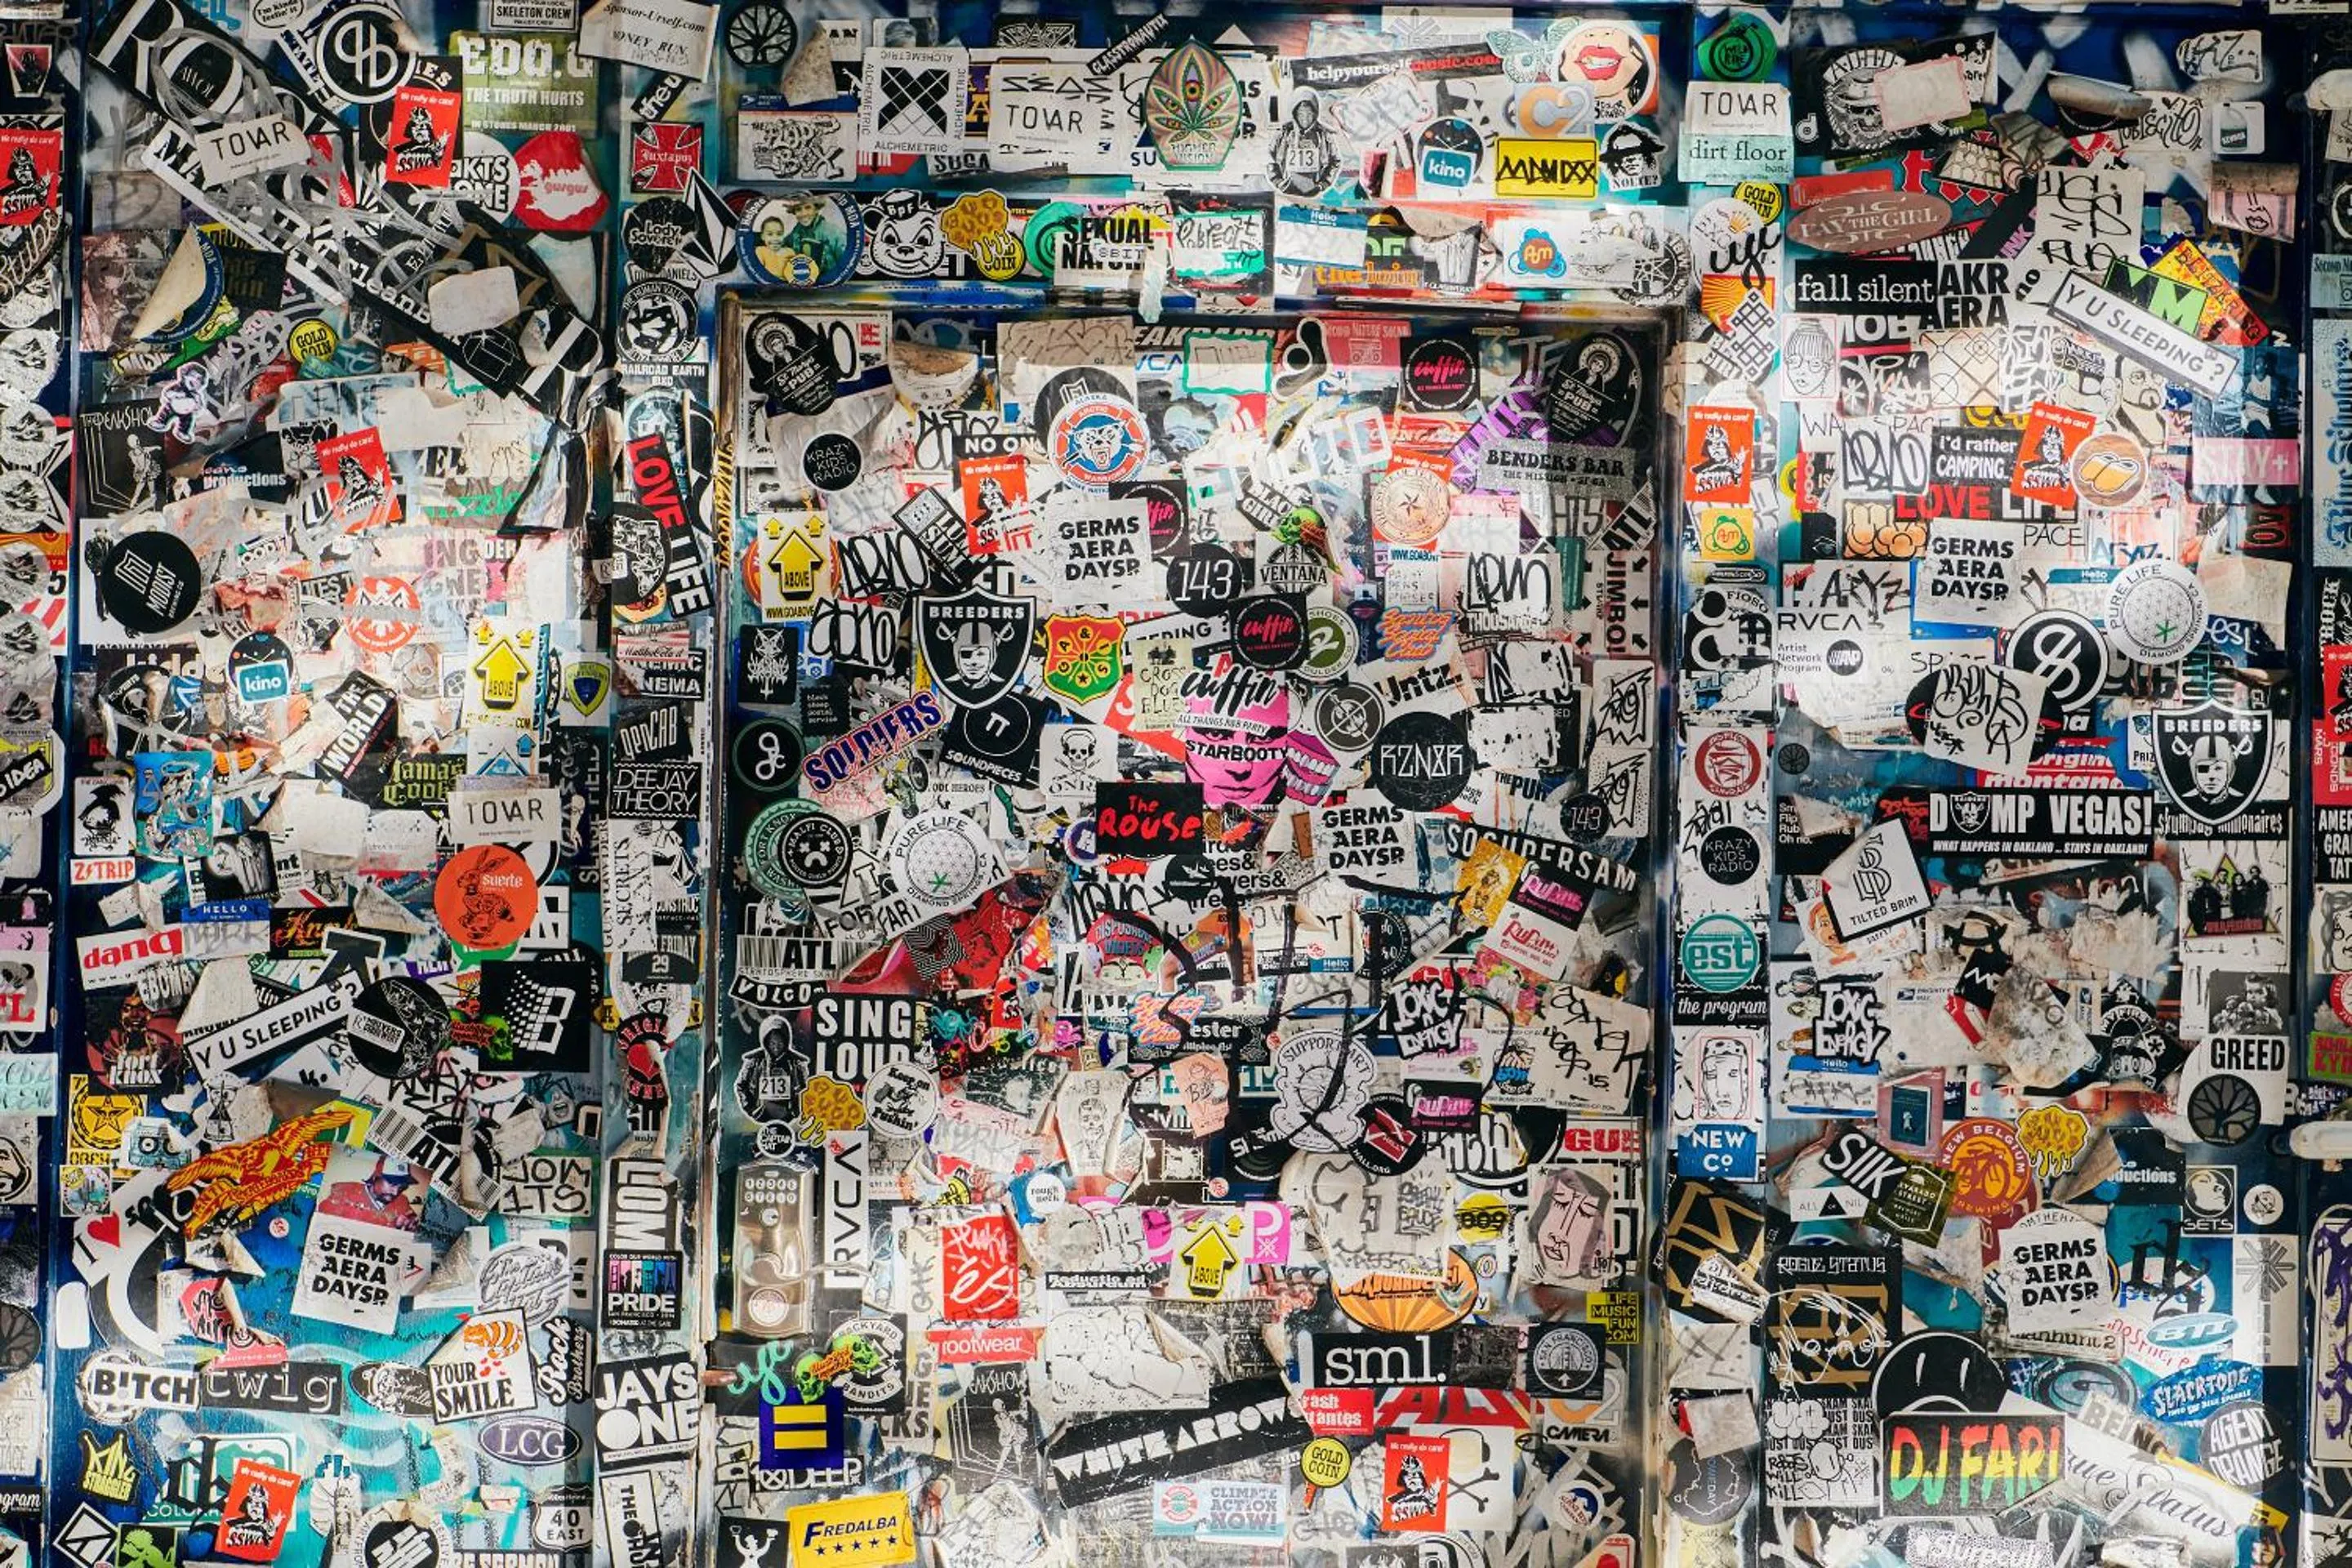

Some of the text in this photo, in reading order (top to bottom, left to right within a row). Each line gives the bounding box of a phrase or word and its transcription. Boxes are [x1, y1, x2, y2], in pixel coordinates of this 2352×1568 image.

[497, 7, 572, 20] SKELETON CREW
[880, 51, 955, 63] ALCHEMETRIC
[466, 88, 584, 106] THE TRUTH HURTS
[862, 63, 873, 136] ALCHEMETRIC
[956, 68, 967, 140] ALCHEMETRIC
[875, 140, 948, 153] ALCHEMETRIC
[1690, 140, 1788, 162] dirt floor
[1290, 149, 1315, 167] 213
[1428, 159, 1464, 179] kino
[1744, 185, 1776, 205] GOLD
[1311, 210, 1338, 222] Hello
[1882, 208, 1939, 227] GIRL
[645, 220, 679, 240] Lady
[1797, 274, 1934, 304] fall silent
[1939, 263, 2010, 295] AKR
[1943, 296, 2009, 327] ERA
[2065, 283, 2083, 305] Y
[2085, 298, 2105, 317] U
[2109, 309, 2204, 369] SLEEPING
[296, 327, 327, 349] GOLD
[672, 364, 706, 377] EARTH
[807, 441, 850, 462] KRAZY
[1966, 435, 2016, 453] rather
[817, 457, 848, 472] KIDS
[1486, 449, 1624, 476] BENDERS BAR
[629, 434, 684, 528] LOVE
[812, 465, 857, 483] RADIO
[1058, 516, 1140, 540] GERMS
[1068, 539, 1135, 559] AERA
[1931, 536, 2014, 560] GERMS
[669, 537, 711, 616] LIFE
[1178, 559, 1233, 600] 143
[1260, 568, 1327, 584] VENTANA
[1941, 559, 2006, 580] AERA
[2081, 569, 2108, 580] Hello
[145, 562, 178, 616] MODIST
[784, 572, 811, 589] ABOVE
[2110, 566, 2162, 629] PURE LIFE
[929, 606, 1026, 620] BREEDERS
[1777, 643, 1807, 653] Artist
[1777, 653, 1823, 663] Network
[244, 675, 282, 693] kino
[487, 678, 514, 697] ABOVE
[1180, 668, 1280, 715] cuffin
[336, 680, 366, 715] THE
[322, 689, 390, 774] WORLD
[2164, 719, 2263, 733] BREEDERS
[803, 689, 944, 793] SOLDIERS
[1186, 739, 1288, 762] STARBOOTY
[944, 749, 1022, 782] SOUNDPIECES
[617, 768, 696, 791] DEEJAY
[612, 791, 694, 812] THEORY
[1129, 795, 1160, 813] The
[1323, 806, 1404, 827] GERMS
[819, 823, 841, 844] CLUB
[897, 817, 968, 858] PURE LIFE
[1334, 827, 1399, 848] AERA
[1779, 835, 1793, 844] Oh
[1705, 839, 1753, 852] KRAZY
[1933, 840, 1958, 851] WHAT
[1960, 840, 1999, 852] HAPPENS
[2002, 841, 2011, 852] IN
[2013, 842, 2054, 853] OAKLAND
[2064, 843, 2090, 853] STAYS
[2092, 843, 2102, 853] IN
[2105, 844, 2148, 854] OAKLAND!
[1708, 860, 1753, 873] RADIO
[1713, 851, 1746, 862] KIDS
[481, 874, 524, 889] Suerte
[615, 836, 632, 924] SECRETS
[203, 903, 248, 914] HELLO
[1850, 895, 1919, 926] TILTED BRIM
[652, 954, 670, 975] 29
[780, 940, 836, 970] ATL
[1689, 941, 1753, 970] est
[817, 998, 912, 1037] SING
[1677, 997, 1767, 1021] the program
[194, 1049, 213, 1067] Y
[221, 1041, 237, 1059] U
[244, 994, 343, 1050] SLEEPING
[2211, 1037, 2286, 1072] GREED
[760, 1076, 787, 1094] 213
[1692, 1129, 1747, 1150] NEW
[1944, 1125, 2027, 1174] NEW BELGIUM
[408, 1134, 461, 1183] ATL
[833, 1142, 862, 1278] RVCA
[1799, 1200, 1819, 1212] ALL
[318, 1232, 401, 1265] GERMS
[2013, 1237, 2097, 1265] GERMS
[321, 1257, 387, 1285] AERA
[1194, 1266, 1220, 1286] ABOVE
[1776, 1256, 1887, 1275] ROGUE STATUS
[2025, 1263, 2094, 1285] AERA
[608, 1294, 675, 1312] PRIDE
[1606, 1294, 1635, 1305] LIFE
[1592, 1305, 1637, 1317] MUSIC
[1609, 1316, 1637, 1330] FUN
[537, 1316, 572, 1406] Rock
[568, 1325, 586, 1401] Brothers
[1325, 1334, 1447, 1385] sml.
[434, 1362, 476, 1386] YOUR
[203, 1367, 337, 1411] twig
[597, 1362, 696, 1410] JAYS
[844, 1381, 895, 1401] BANDITS
[436, 1379, 516, 1418] SMILE
[597, 1400, 699, 1450] ONE
[2209, 1406, 2274, 1452] AGENT
[500, 1429, 568, 1459] LCG
[1053, 1429, 1172, 1481] WHITE
[1311, 1446, 1343, 1465] GOLD
[2209, 1438, 2283, 1488] ORANGE
[1307, 1460, 1342, 1477] COIN
[1890, 1426, 1951, 1506] DJ
[83, 1473, 132, 1500] STRAGGLER
[1209, 1486, 1278, 1500] CLIMATE
[1209, 1499, 1277, 1512] ACTION
[550, 1508, 581, 1528] 40
[1209, 1512, 1278, 1530] NOW!
[546, 1528, 586, 1542] EAST
[803, 1517, 898, 1548] FREDALBA
